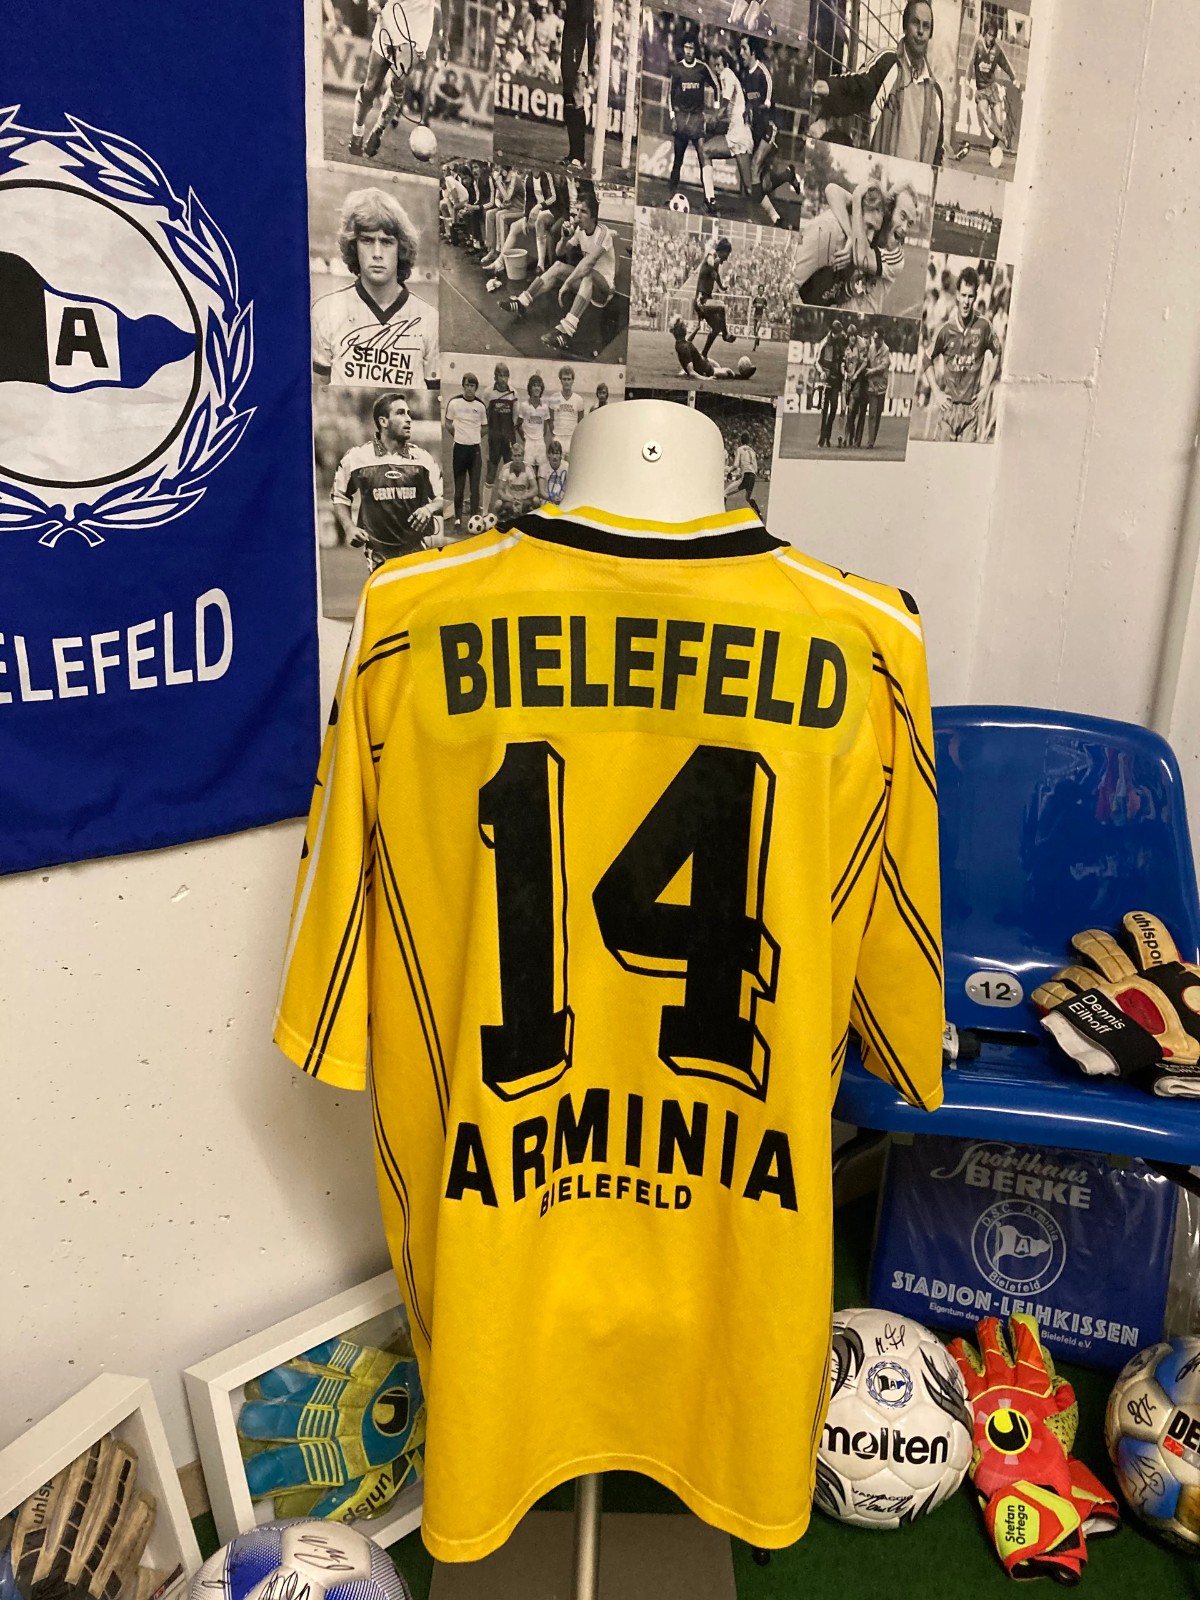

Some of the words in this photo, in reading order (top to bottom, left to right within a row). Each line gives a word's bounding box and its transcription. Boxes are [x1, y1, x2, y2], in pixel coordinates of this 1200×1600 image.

[55, 306, 109, 368] A
[353, 346, 411, 370] SEIDEN
[344, 361, 414, 386] STICKER
[440, 616, 848, 729] BIELEFELD
[479, 741, 781, 1102] 14
[980, 981, 1012, 1001] 12
[1082, 994, 1126, 1030] Dennis
[1068, 1001, 1113, 1034] Eilhoff
[445, 1088, 798, 1212] ARMINIA
[930, 1142, 1089, 1184] Sporthaus
[540, 1173, 692, 1218] BIELEFELD
[965, 1164, 1092, 1209] BERKE
[1023, 1205, 1058, 1241] Arminia
[988, 1271, 1041, 1292] Bielefeld
[929, 1302, 964, 1318] Eigentum
[965, 1311, 980, 1322] des
[1041, 1330, 1077, 1347] Bielefeld
[819, 1423, 950, 1465] molten
[1167, 1410, 1200, 1455] DE
[1005, 1505, 1015, 1542] Stefan
[1016, 1505, 1028, 1545] Ortega
